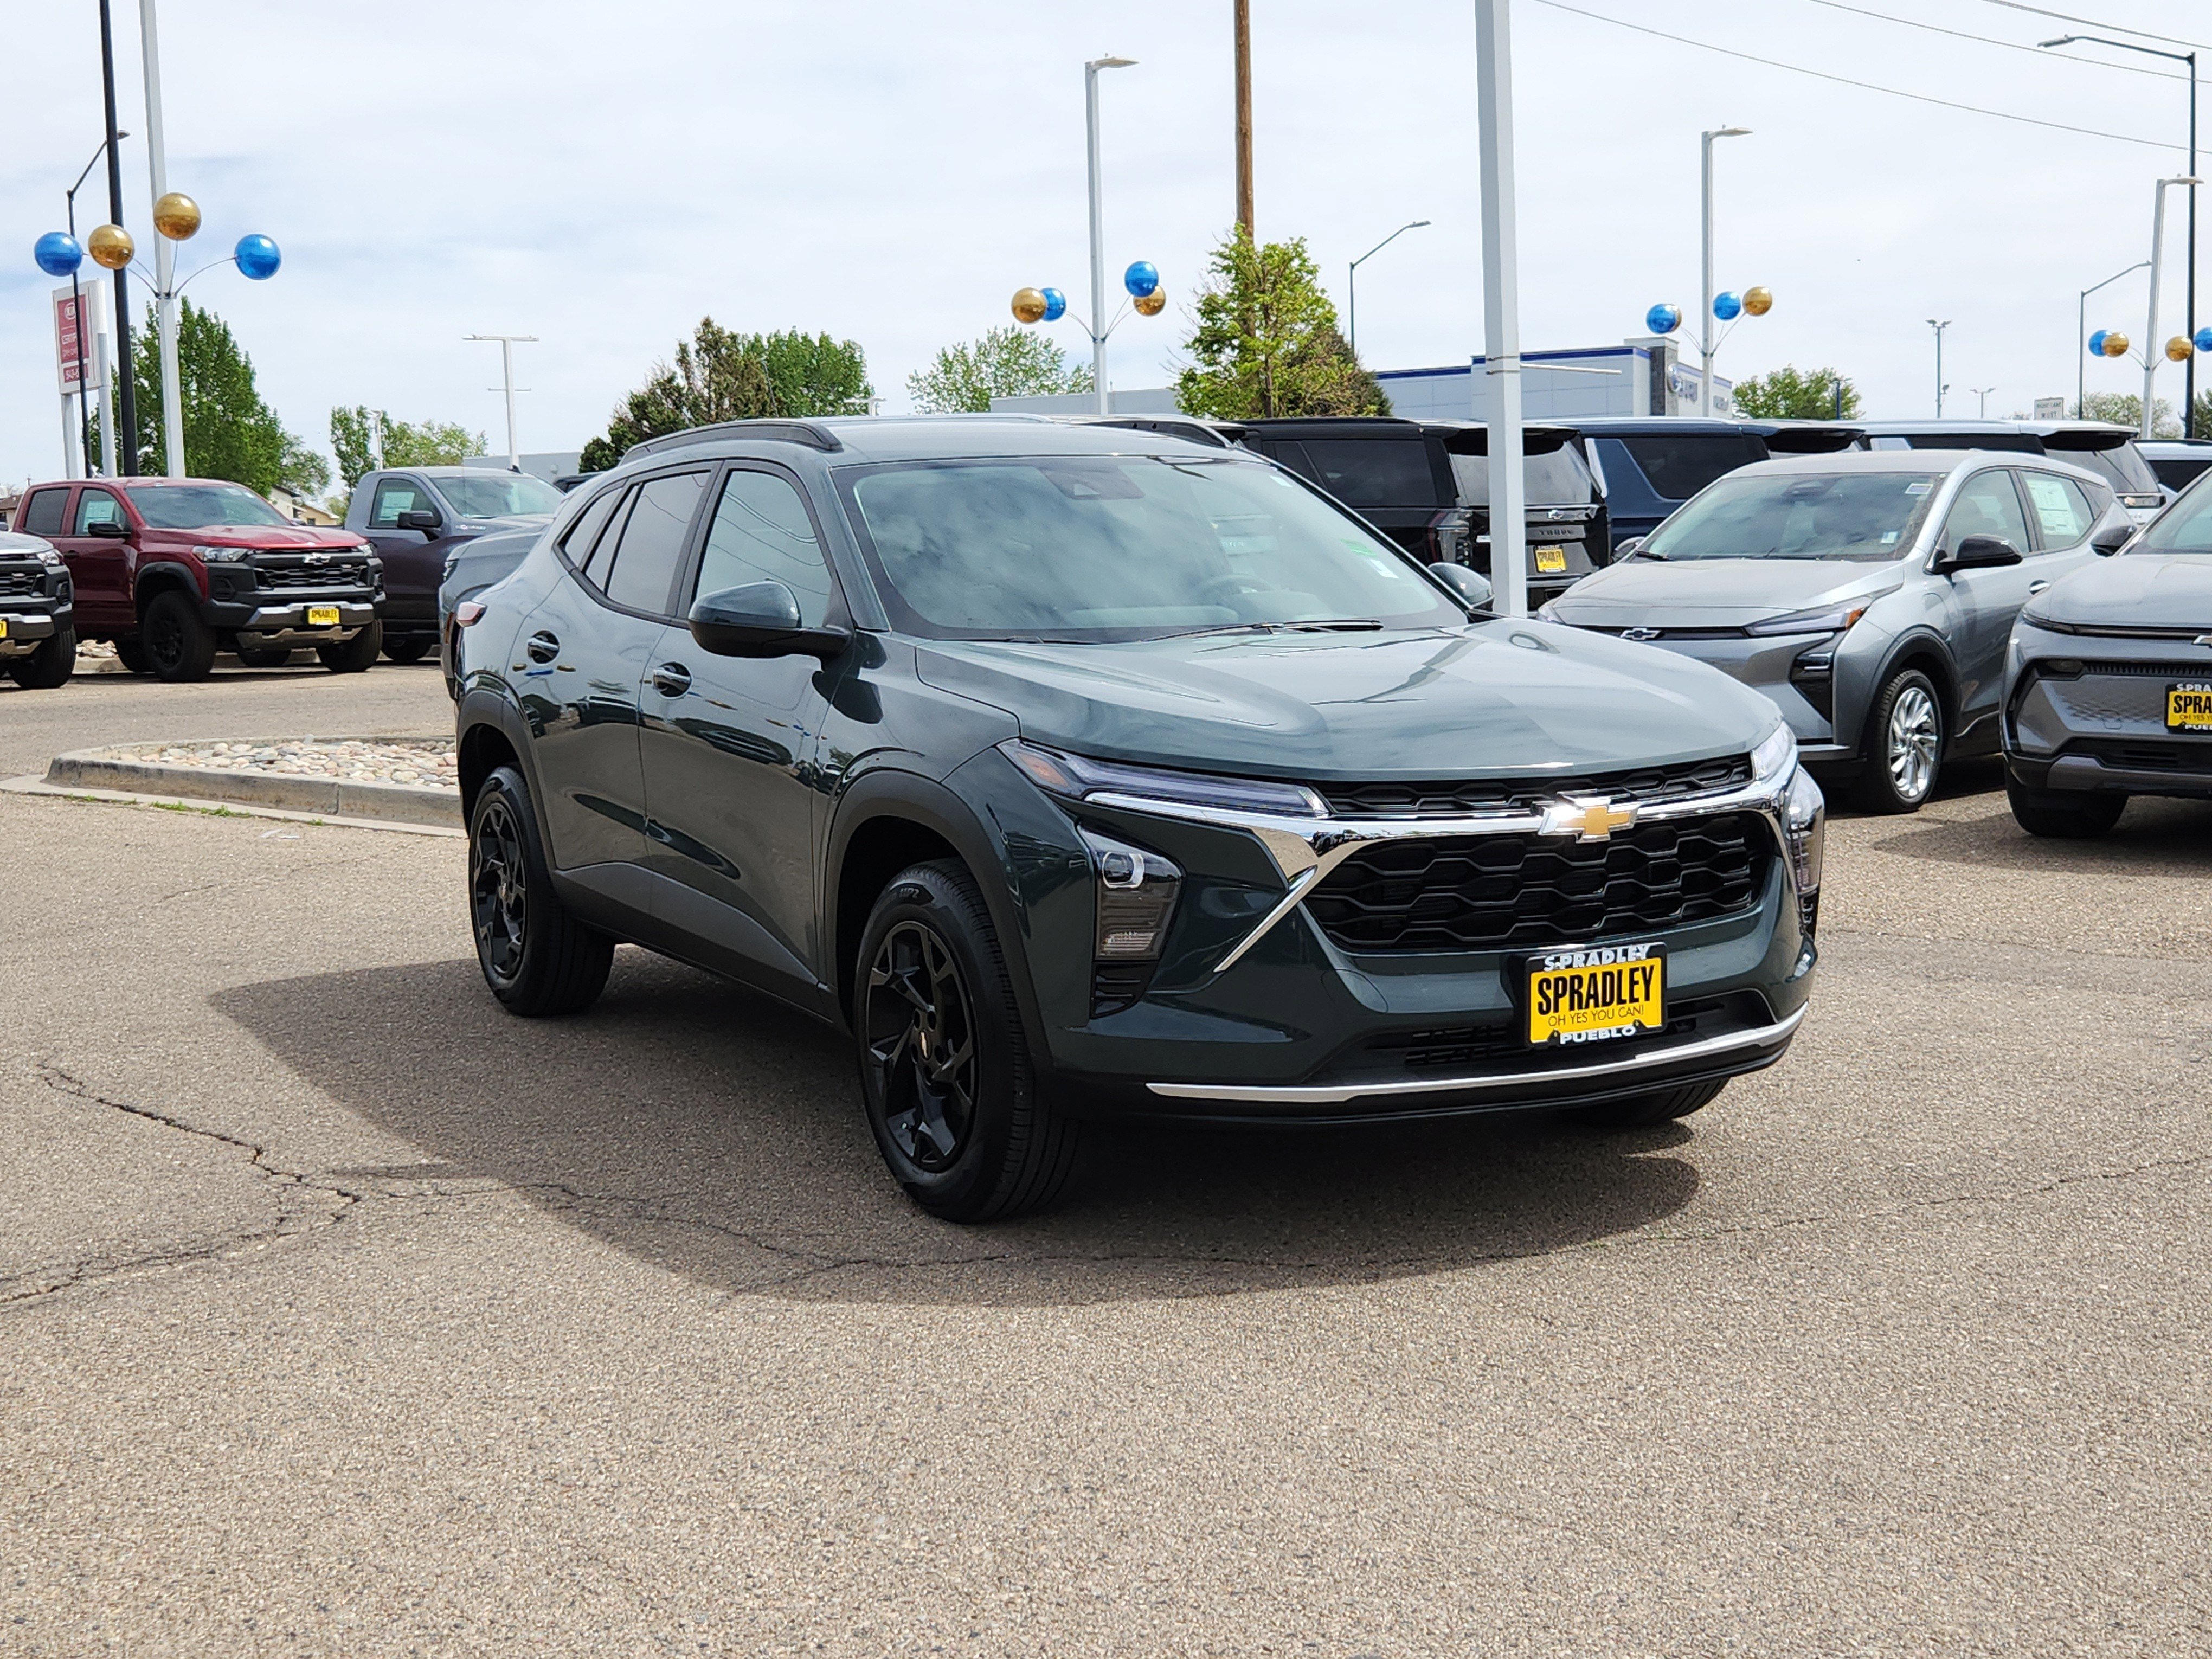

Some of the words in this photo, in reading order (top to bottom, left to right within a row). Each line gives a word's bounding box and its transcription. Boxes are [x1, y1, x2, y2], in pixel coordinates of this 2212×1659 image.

[2176, 683, 2211, 692] SPRA
[1544, 944, 1651, 972] SPRADLEY
[1538, 964, 1655, 1015] SPRADLEY
[1548, 1014, 1566, 1027] OH
[1570, 1012, 1587, 1024] YES
[1591, 1008, 1615, 1021] YOU
[1618, 1005, 1644, 1018] CAN!
[1560, 1025, 1636, 1044] PUEBLO
